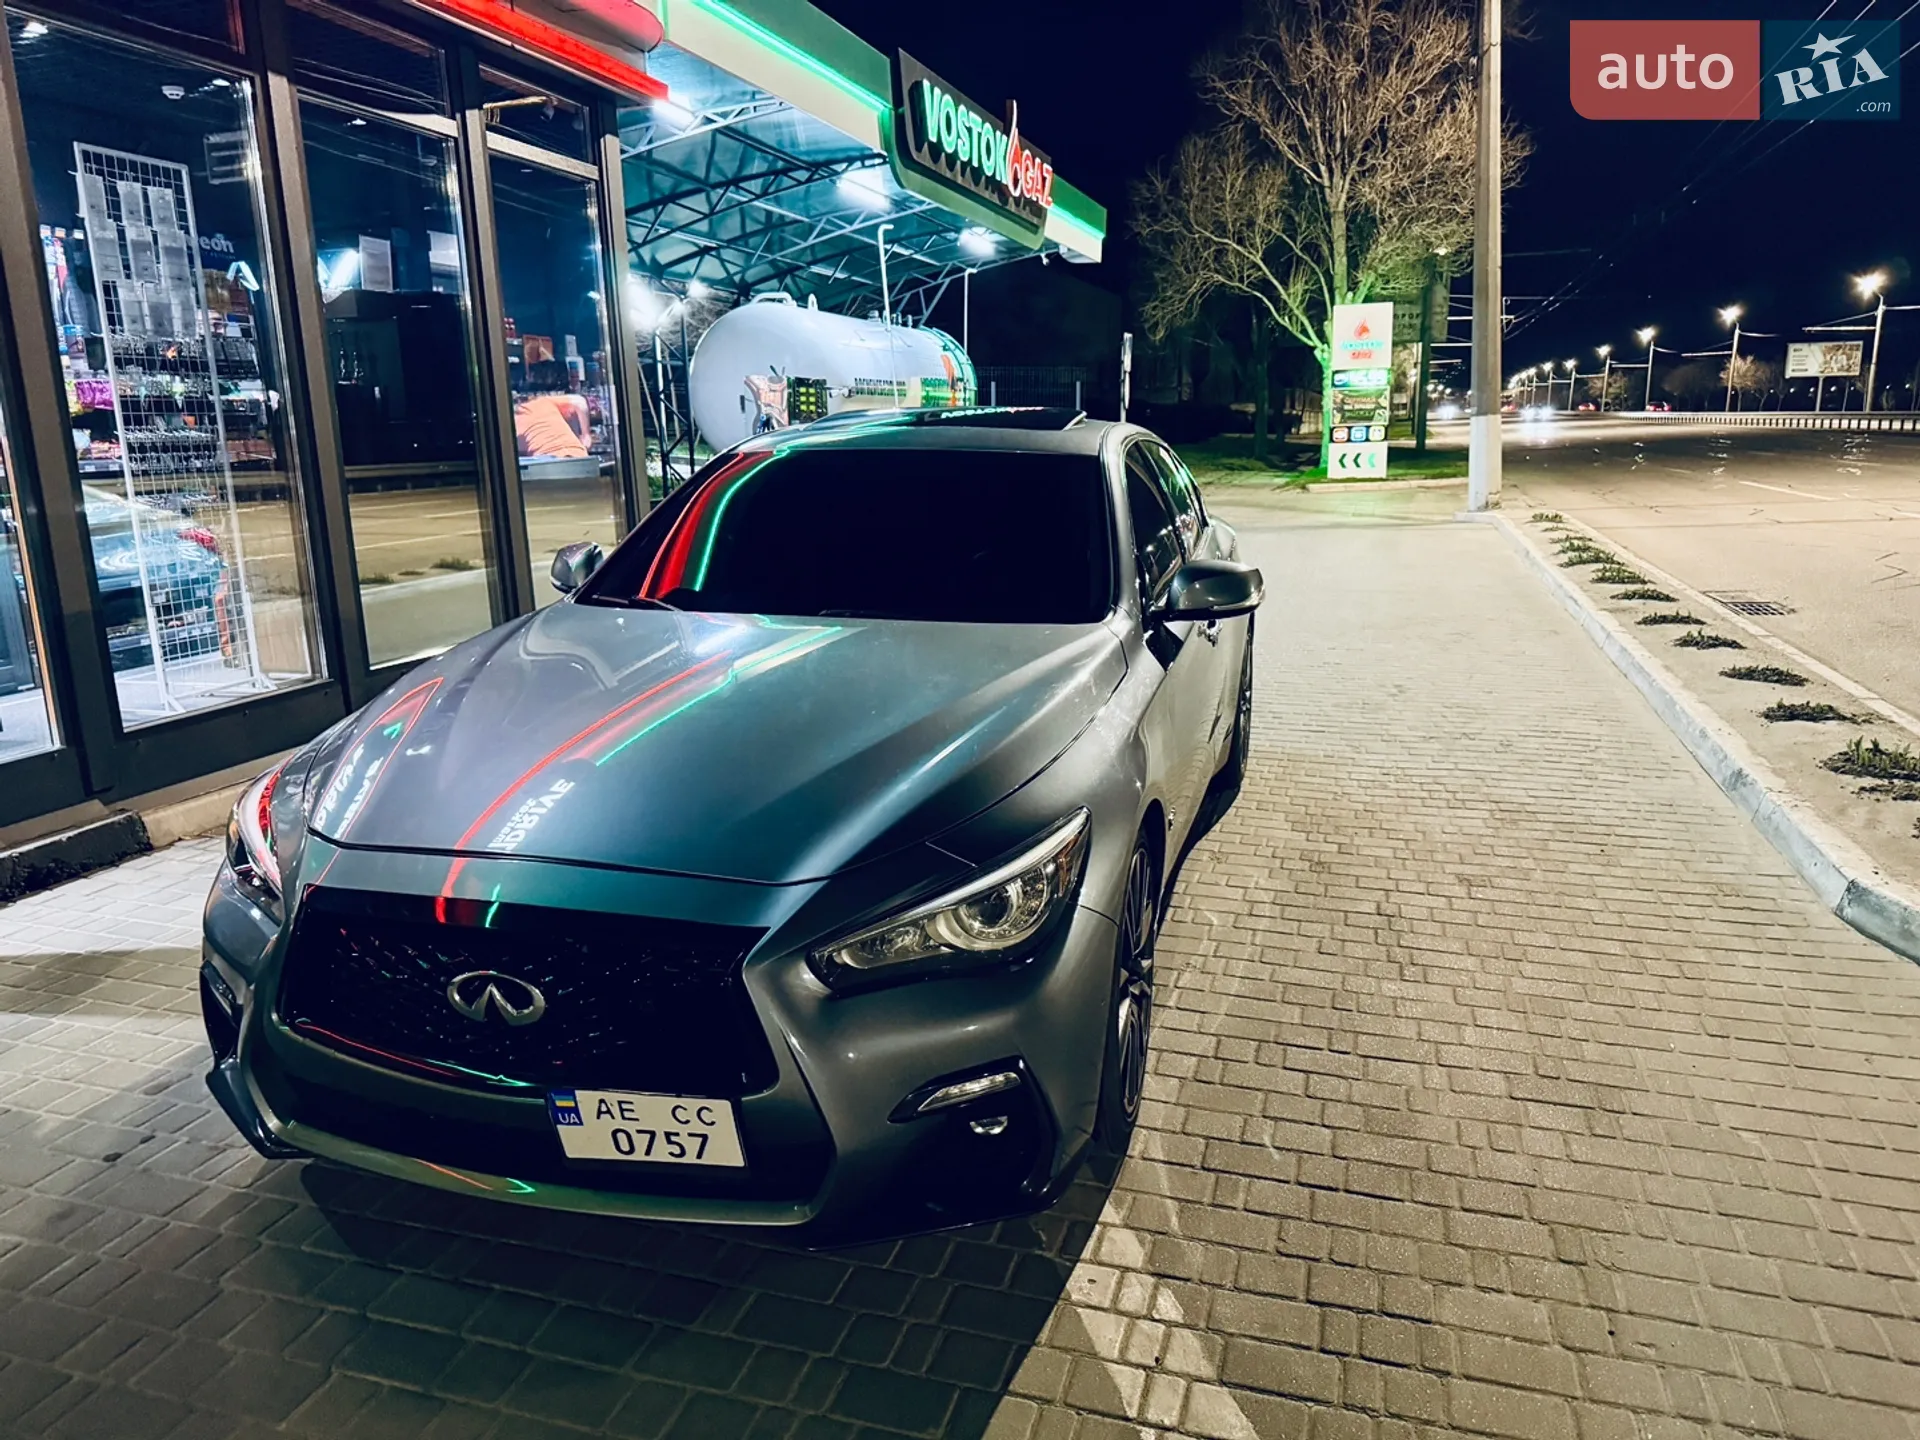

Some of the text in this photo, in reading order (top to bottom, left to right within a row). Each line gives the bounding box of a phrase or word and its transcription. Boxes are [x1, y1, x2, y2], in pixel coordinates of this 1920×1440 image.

[922, 78, 1054, 209] VOSTOK GAZ
[558, 1112, 581, 1125] UA
[596, 1098, 716, 1127] AE CC
[611, 1128, 709, 1160] 0757
